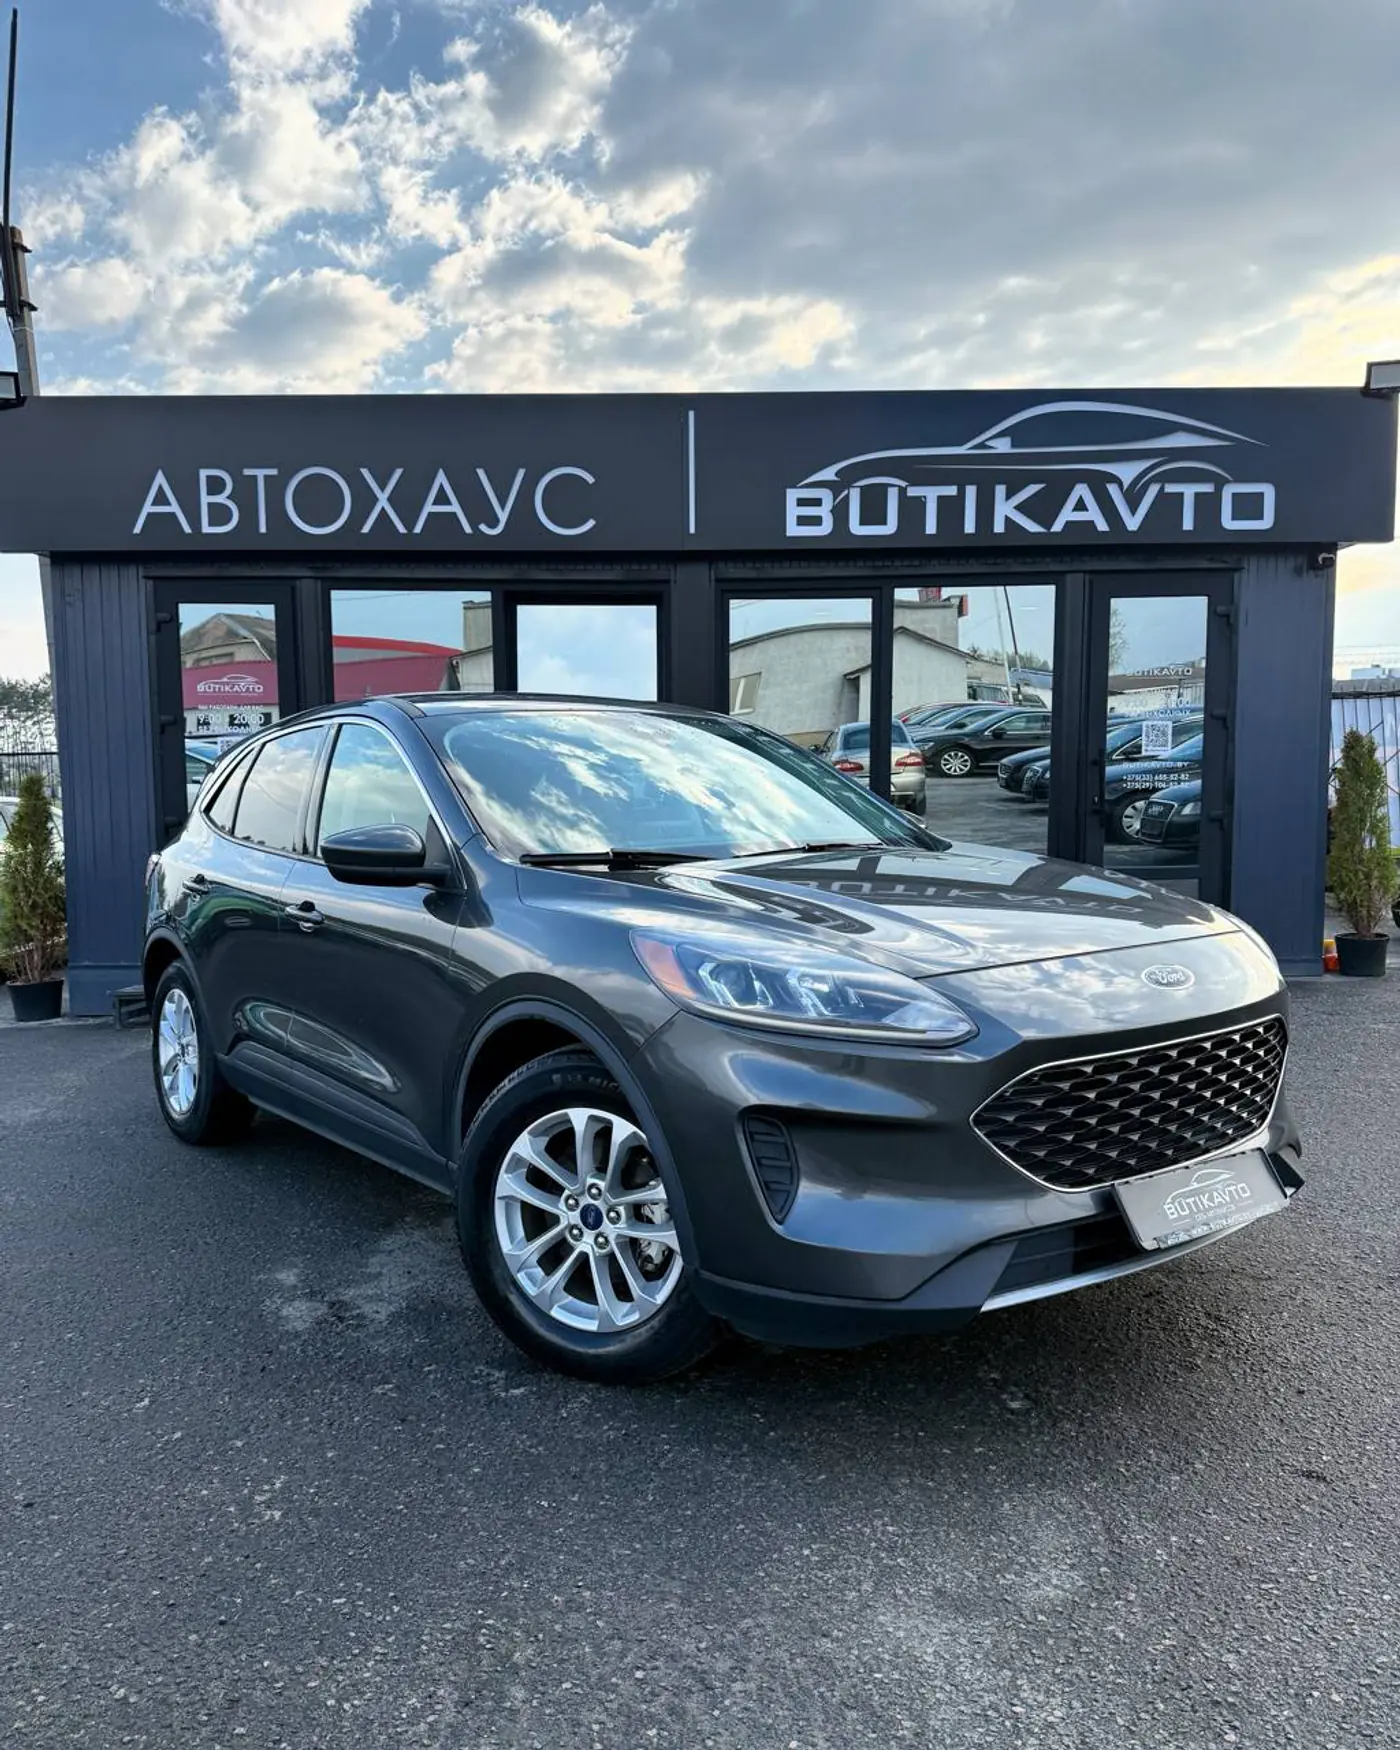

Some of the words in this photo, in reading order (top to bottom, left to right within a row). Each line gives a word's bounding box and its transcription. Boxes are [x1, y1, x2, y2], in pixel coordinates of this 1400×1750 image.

[133, 466, 597, 536] АВТОХАУС
[786, 482, 1276, 538] BUTIKAVTO
[197, 683, 264, 692] BUTIKAVTO
[1163, 1182, 1251, 1220] BUTIKAVTO
